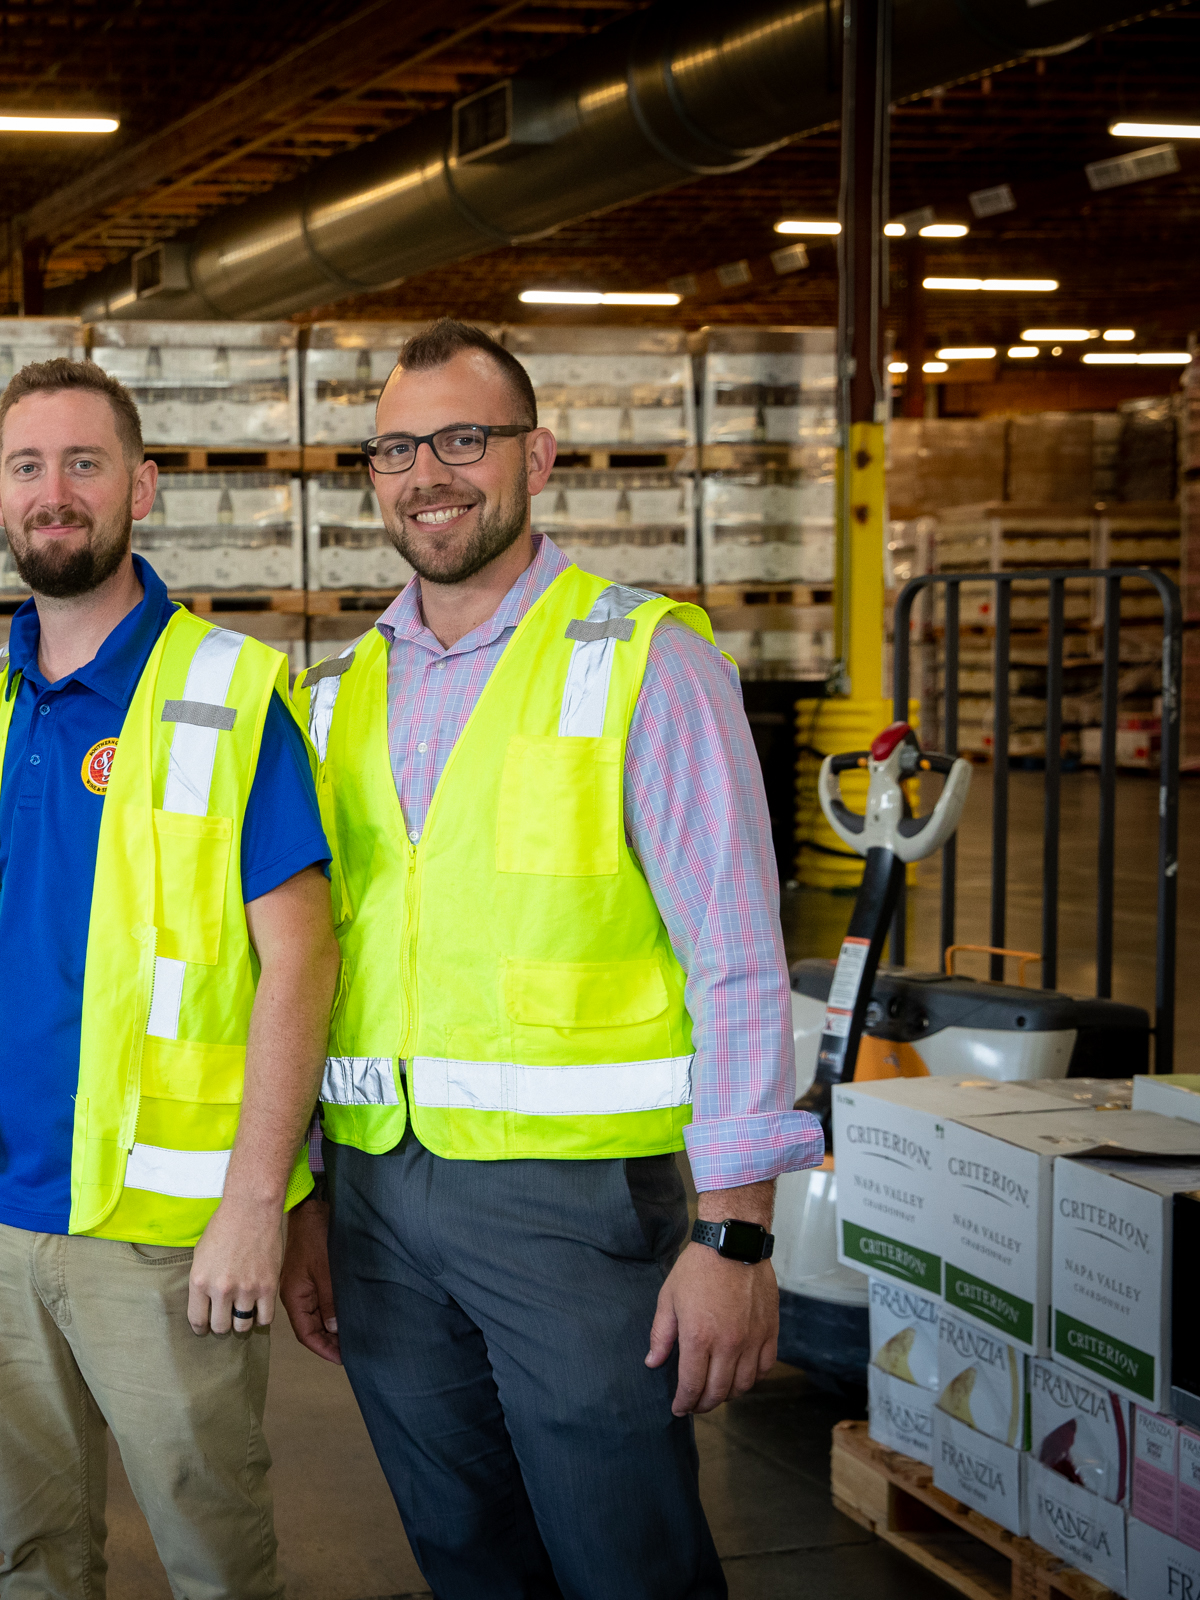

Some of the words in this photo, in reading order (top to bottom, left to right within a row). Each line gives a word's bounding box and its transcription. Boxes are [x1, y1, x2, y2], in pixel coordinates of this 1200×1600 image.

[89, 740, 115, 755] SOUTHERN
[86, 779, 96, 790] WINE
[854, 1174, 881, 1195] NAPA
[883, 1184, 924, 1209] VALLEY
[953, 1213, 979, 1235] NAPA
[981, 1226, 1022, 1253] VALLEY
[859, 1237, 927, 1277] CRITERION
[1064, 1258, 1094, 1282] NAPA
[1096, 1271, 1141, 1302] VALLEY
[1073, 1283, 1131, 1316] CHARDONNAY
[872, 1282, 939, 1325] FRANZI
[955, 1280, 1020, 1324] CRITERION
[939, 1317, 1007, 1372] FRANZIA
[1067, 1329, 1139, 1378] CRITERION
[1033, 1364, 1110, 1423] FRANZIA
[1139, 1413, 1173, 1440] FRANZIA
[942, 1441, 1006, 1496] FRANZIA
